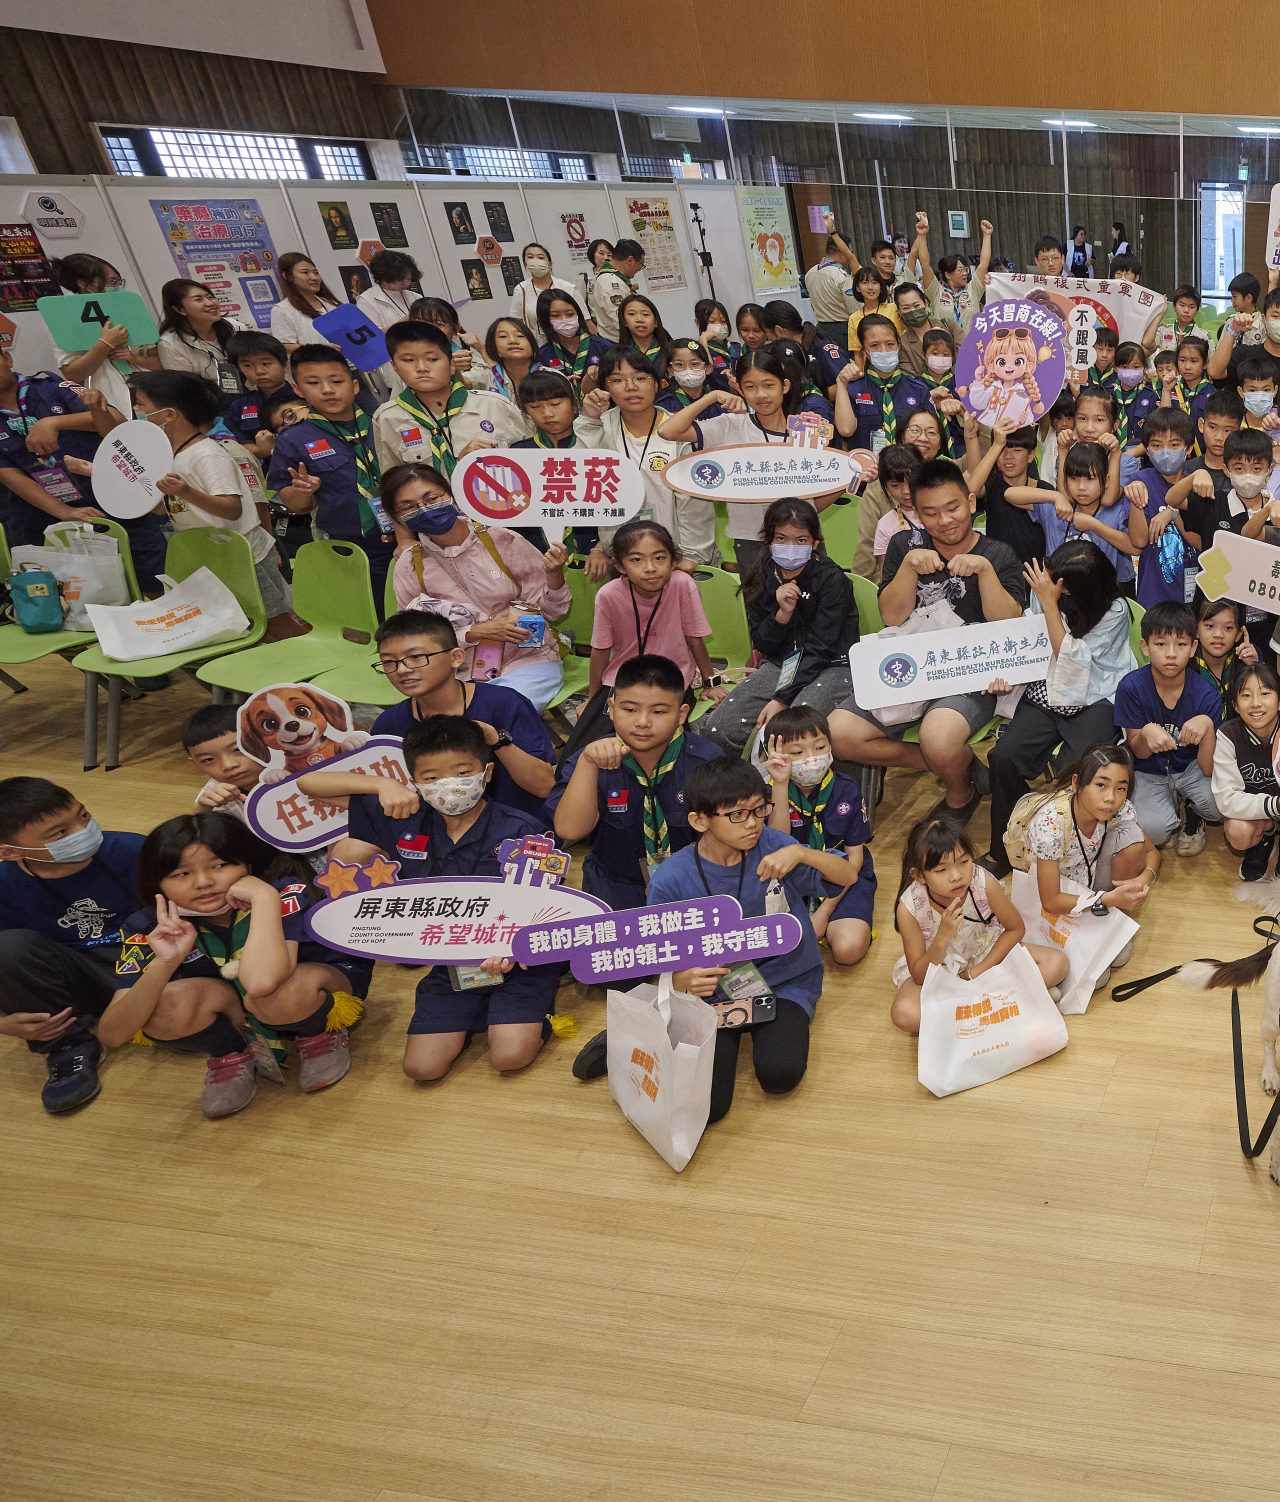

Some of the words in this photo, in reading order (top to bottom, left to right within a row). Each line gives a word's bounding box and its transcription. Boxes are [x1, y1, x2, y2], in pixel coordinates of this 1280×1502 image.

[81, 300, 111, 328] 4
[347, 325, 375, 345] 5
[1074, 309, 1089, 365] 不跟風
[539, 456, 621, 504] 禁菸
[926, 667, 955, 677] PUBLIC
[955, 662, 985, 674] HEALTH
[985, 657, 1016, 668] BUREAU
[1016, 654, 1027, 662] OF
[927, 670, 967, 682] PINGTUNG
[968, 665, 999, 675] COUNTY
[999, 655, 1050, 670] GOVERNMENT
[353, 896, 491, 920] 屏東縣政府
[419, 923, 519, 946] 希望城市
